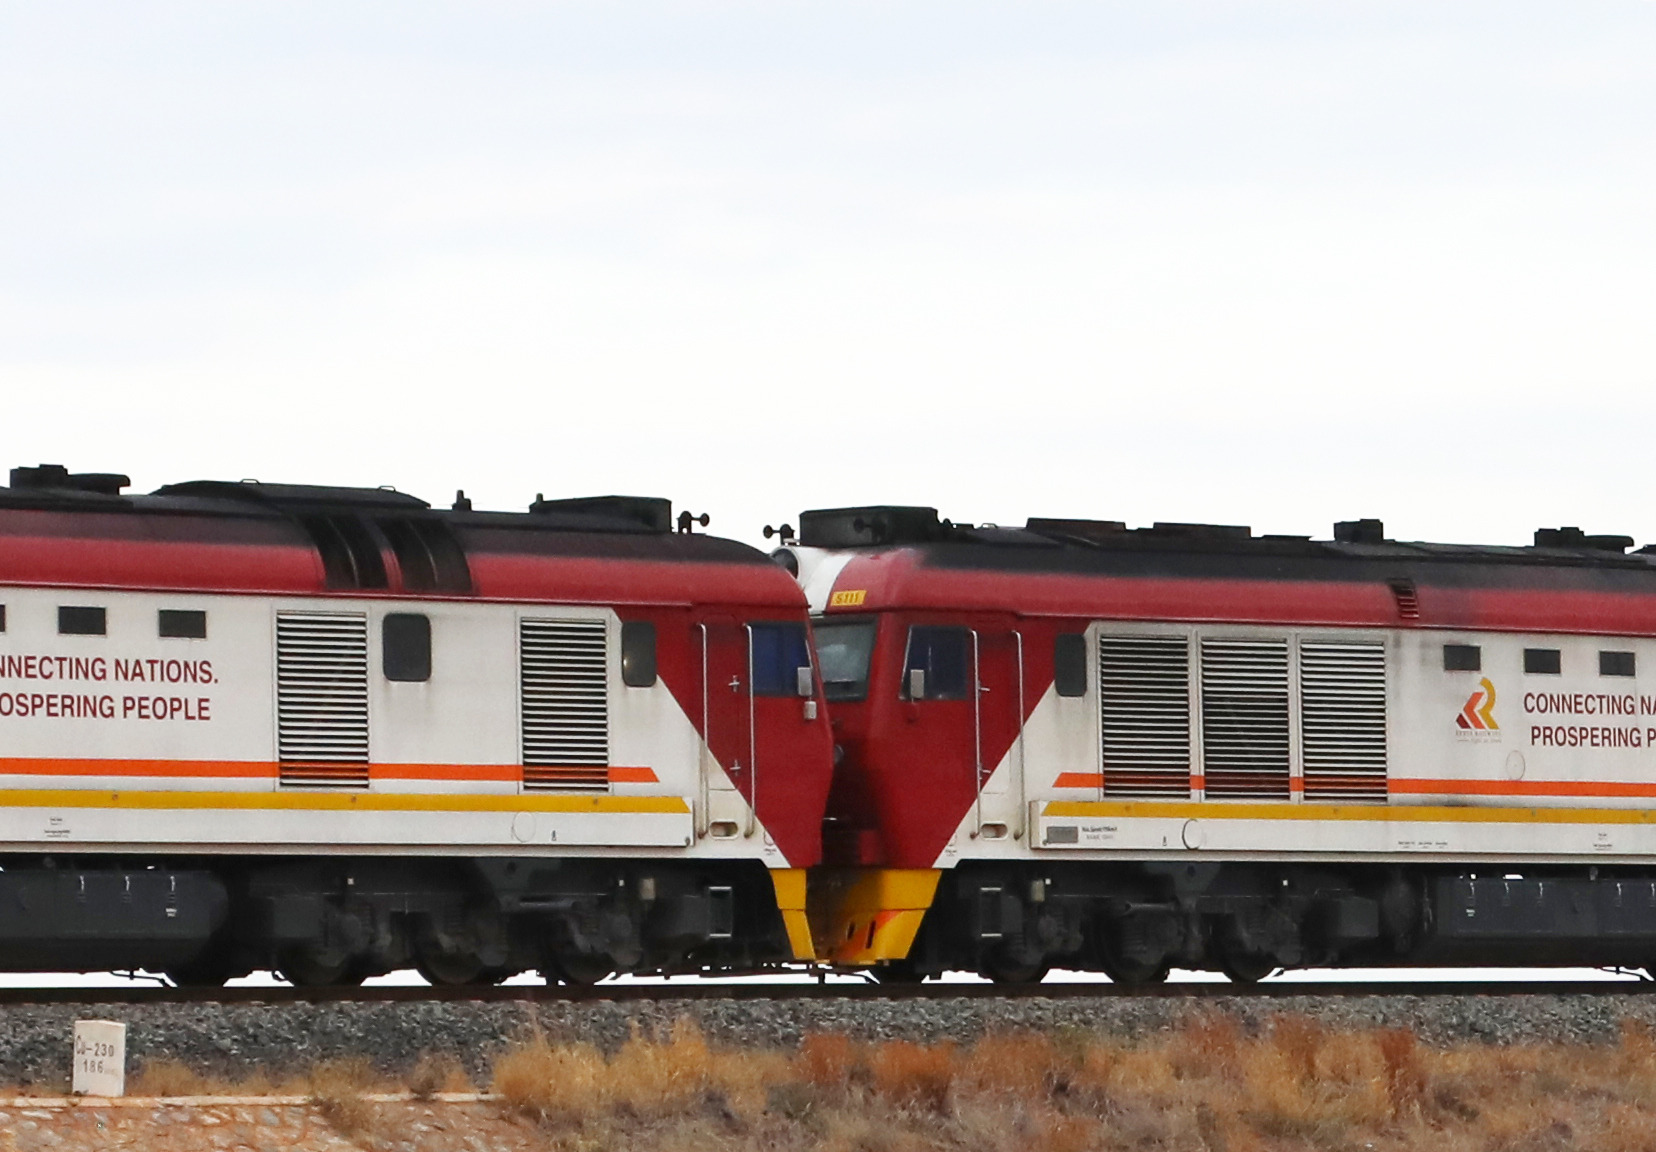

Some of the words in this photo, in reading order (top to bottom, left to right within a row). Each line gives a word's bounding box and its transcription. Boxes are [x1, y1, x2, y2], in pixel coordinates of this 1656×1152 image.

[114, 658, 219, 684] NATIONS.
[123, 696, 211, 720] PEOPLE
[1524, 692, 1635, 715] CONNECTING
[1531, 725, 1642, 748] PROSPERING
